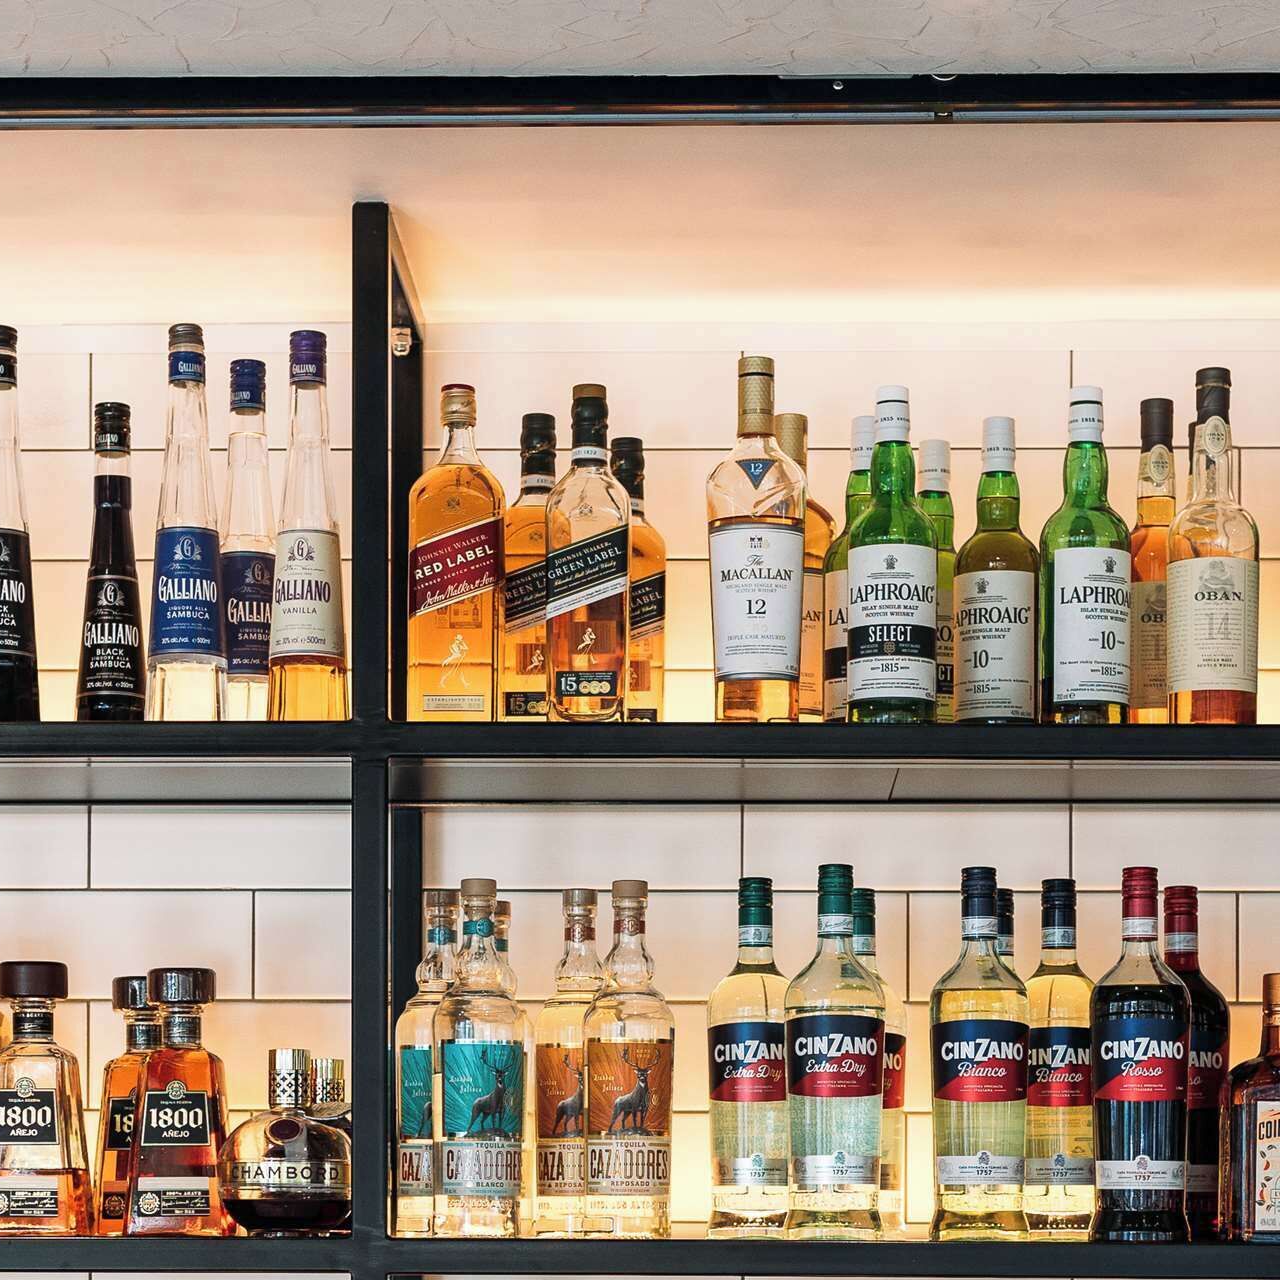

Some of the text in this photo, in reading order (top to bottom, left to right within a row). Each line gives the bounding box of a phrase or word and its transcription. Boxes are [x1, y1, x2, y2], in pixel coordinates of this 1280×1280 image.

[418, 534, 488, 564] JOHNNIE WALKER
[414, 543, 495, 581] RED LABEL
[548, 545, 622, 580] GREEN LABEL
[720, 569, 793, 582] MACALLAN
[158, 576, 218, 604] GALLIANO
[275, 578, 331, 604] GALLIANO
[850, 583, 934, 605] LAPHROAIG
[1194, 591, 1243, 601] OBAN
[166, 610, 210, 620] SAMBUCA
[282, 607, 318, 615] VANILLA
[746, 598, 767, 616] 12
[84, 621, 140, 648] GALLIANO
[869, 625, 912, 642] SELECT
[1100, 629, 1117, 651] 10
[96, 648, 124, 656] BLACK
[972, 649, 989, 669] 10
[90, 660, 132, 669] SAMBUCA
[560, 676, 578, 691] 15
[794, 1033, 878, 1057] CINZANO
[941, 1038, 1023, 1062] CINZANO
[1100, 1036, 1184, 1060] CINZANO
[723, 1065, 783, 1082] Extra Dry
[805, 1059, 866, 1076] Extra Dry
[957, 1062, 1008, 1077] Bianco
[1035, 1067, 1084, 1083] Bianco
[1120, 1061, 1164, 1077] Rosso
[149, 1106, 202, 1129] 1800
[9, 1126, 38, 1137] AÑEJO
[161, 1129, 190, 1138] AÑEJO
[615, 1141, 647, 1149] TEQUILA
[231, 1165, 340, 1181] CHAMBORD
[589, 1149, 669, 1180] CAZADORES
